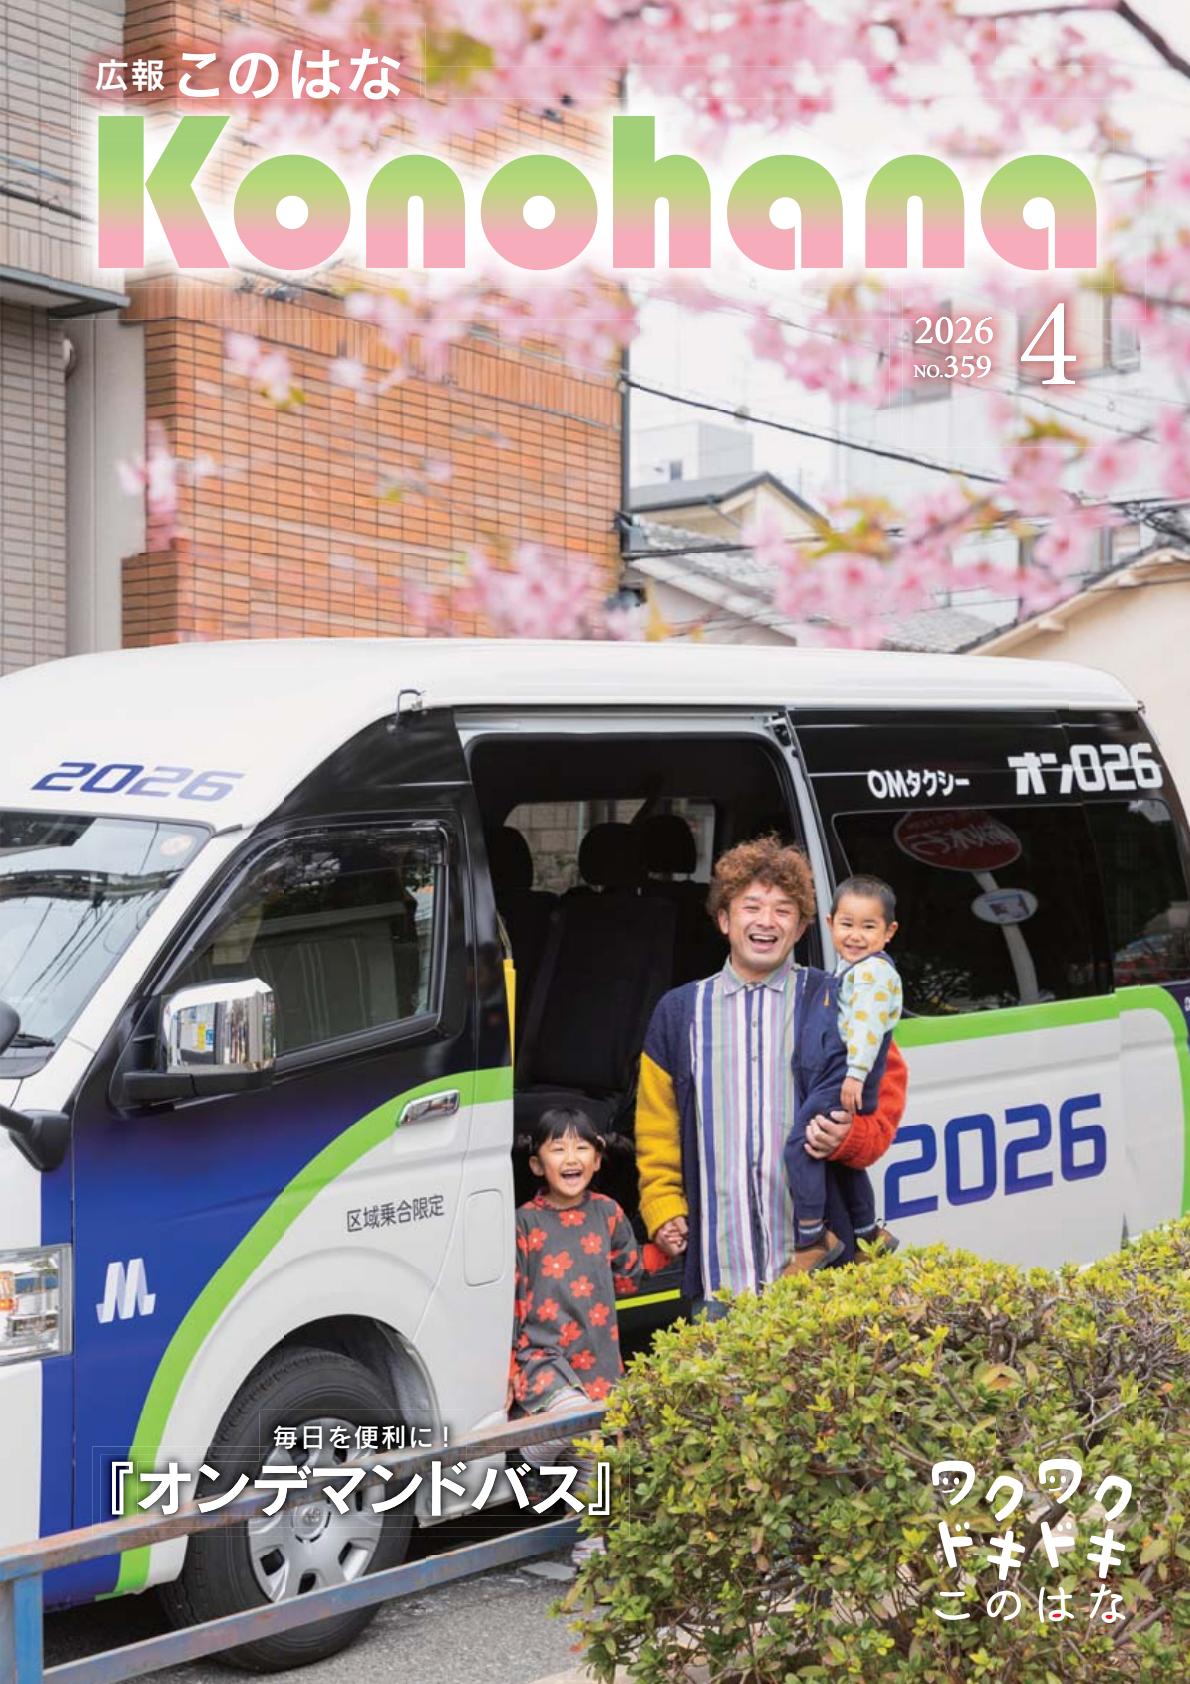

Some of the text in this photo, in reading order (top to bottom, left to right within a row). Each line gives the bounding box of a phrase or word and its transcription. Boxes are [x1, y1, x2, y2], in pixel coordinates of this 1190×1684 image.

[31, 762, 245, 802] 2026
[867, 769, 970, 799] OMタクシー
[884, 1093, 1107, 1221] 2026
[347, 1195, 444, 1232] 区域乗合限定
